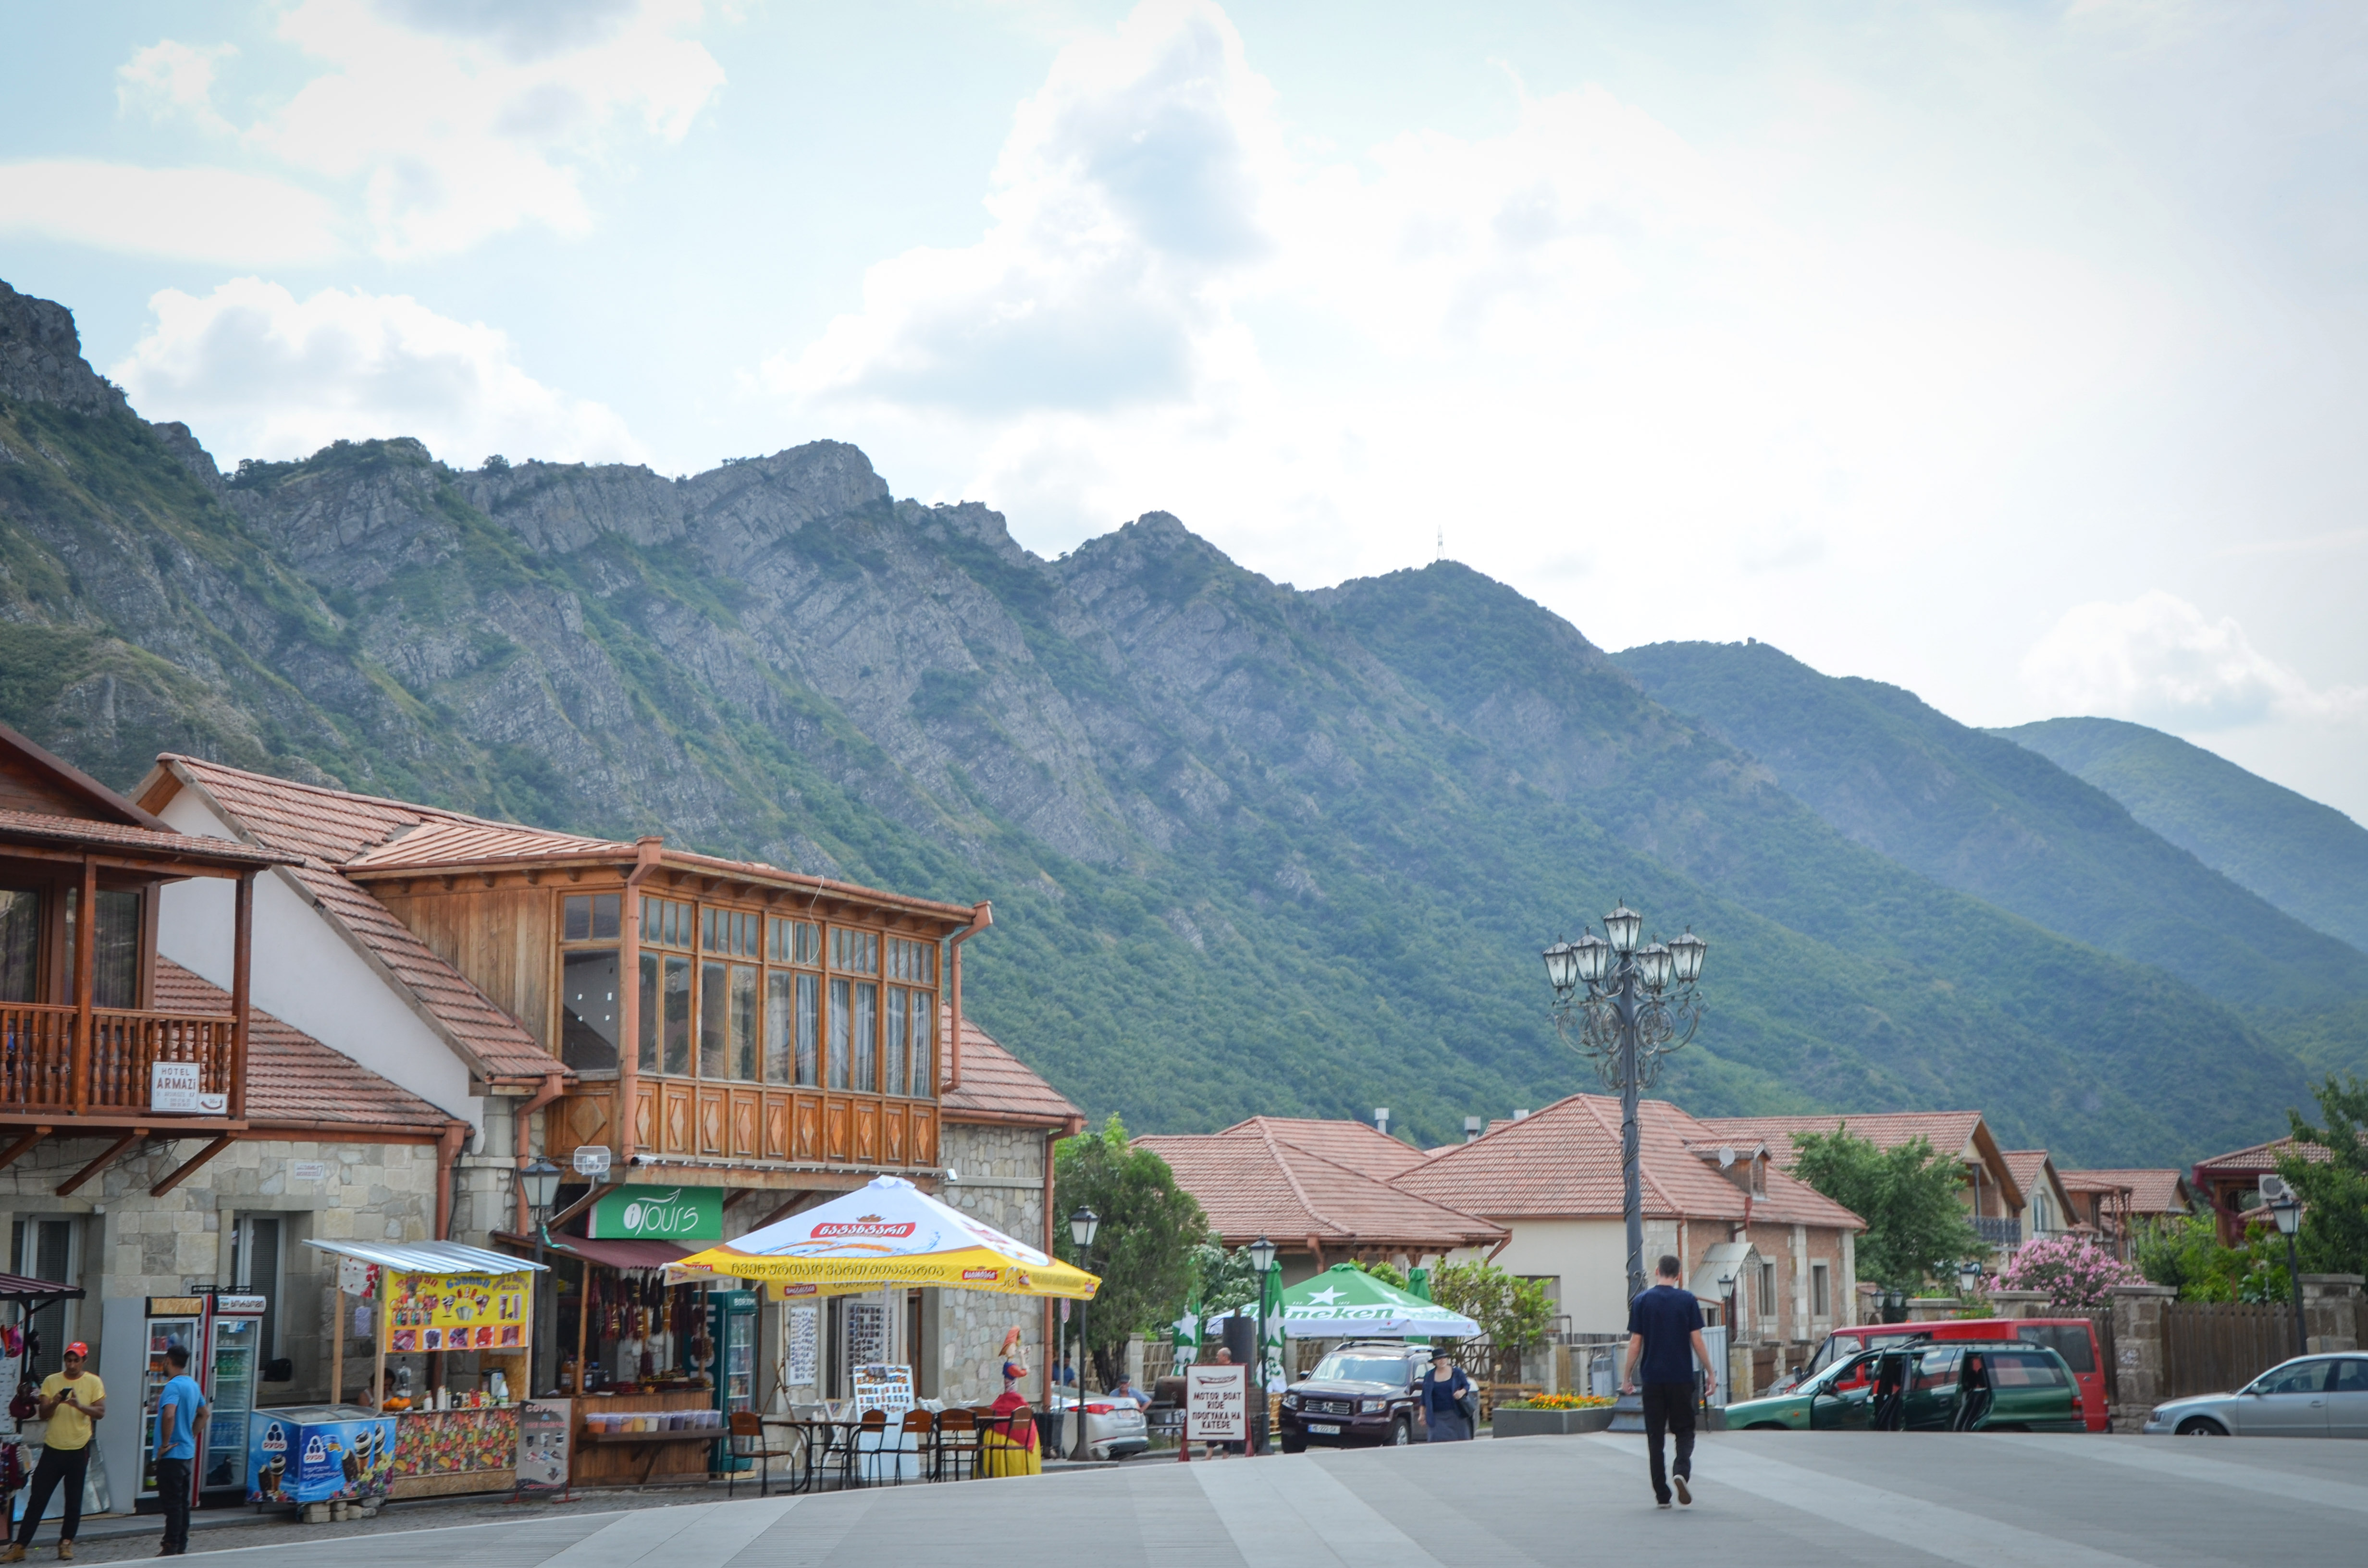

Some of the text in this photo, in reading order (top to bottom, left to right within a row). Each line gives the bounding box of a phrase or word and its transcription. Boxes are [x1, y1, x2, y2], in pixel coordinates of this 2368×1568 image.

[819, 1225, 908, 1235] ნატახტარი
[731, 1263, 944, 1276] ჩვენ ერთად ვართ მთავარია
[1207, 1401, 1224, 1409] RIDE
[1192, 1412, 1241, 1420] ПРОГУЛКА НА
[1202, 1421, 1231, 1429] КАТЕРЕ
